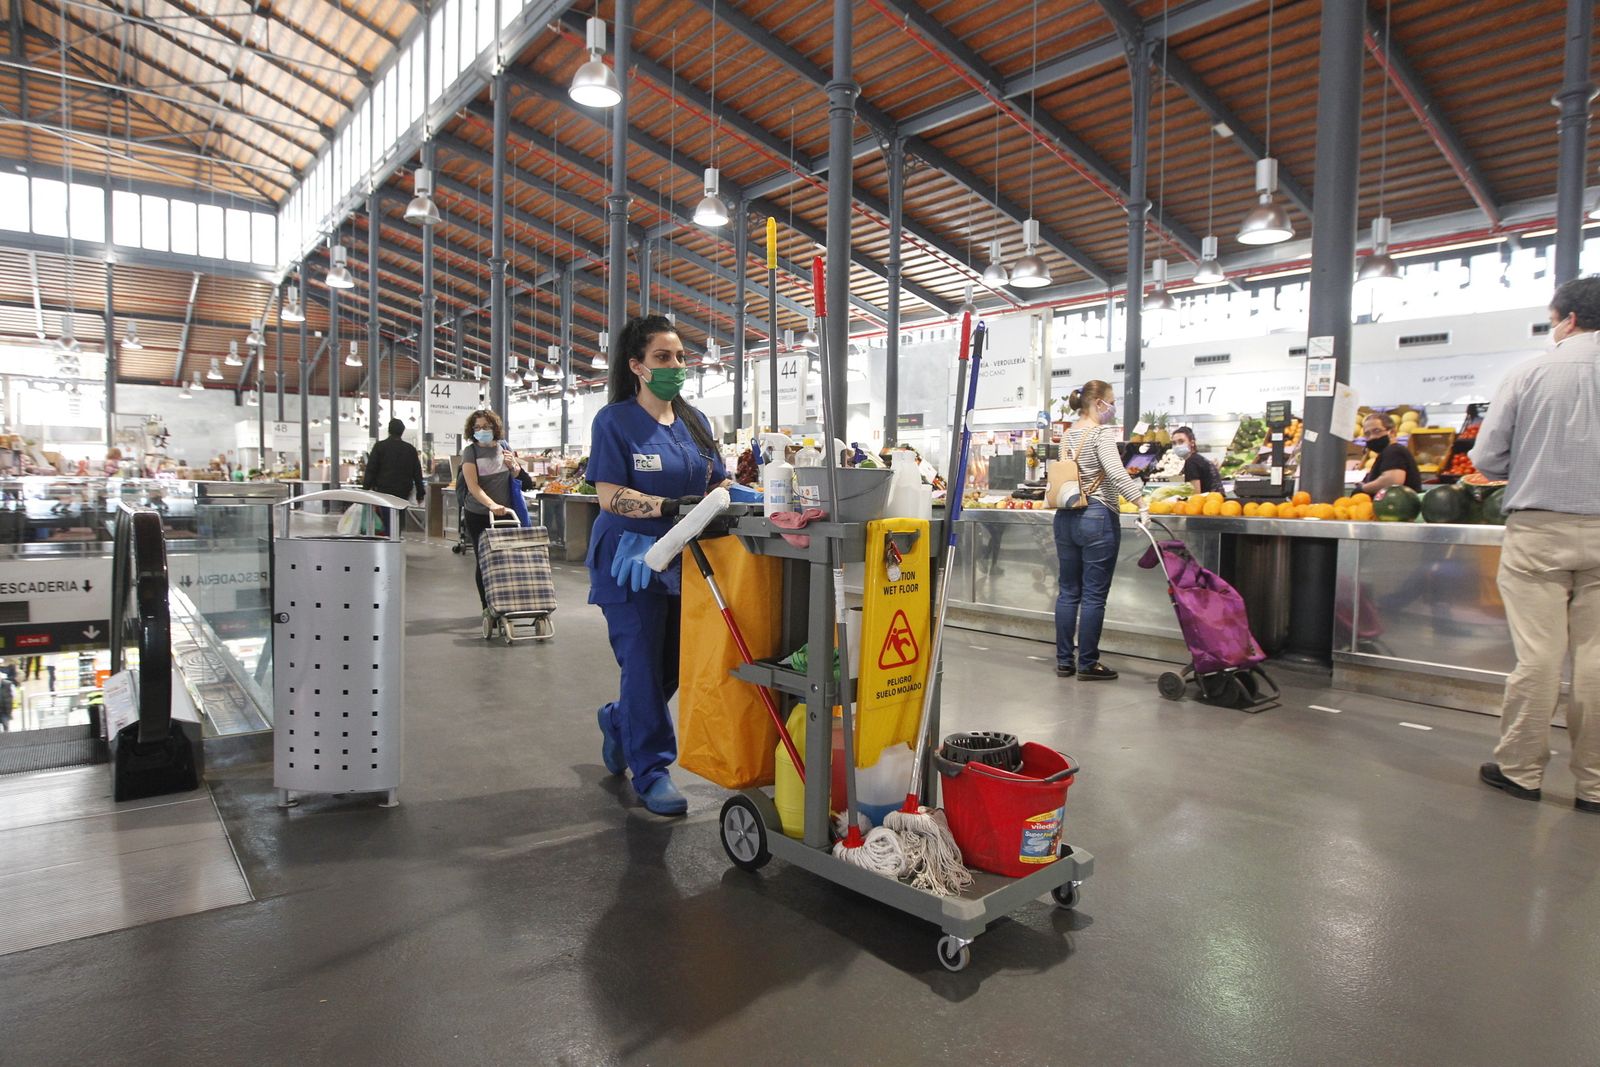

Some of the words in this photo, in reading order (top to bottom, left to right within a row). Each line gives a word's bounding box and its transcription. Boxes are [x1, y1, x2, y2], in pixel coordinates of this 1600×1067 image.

[993, 356, 1026, 367] VERDULERÍA
[781, 360, 797, 379] 44
[430, 383, 451, 398] 44
[1195, 386, 1216, 404] 17
[274, 424, 288, 433] 48
[883, 585, 898, 596] WET
[898, 583, 919, 594] FLOOR
[887, 674, 912, 686] PELIGRO
[876, 688, 897, 700] SUELO
[897, 682, 922, 695] MOJADO
